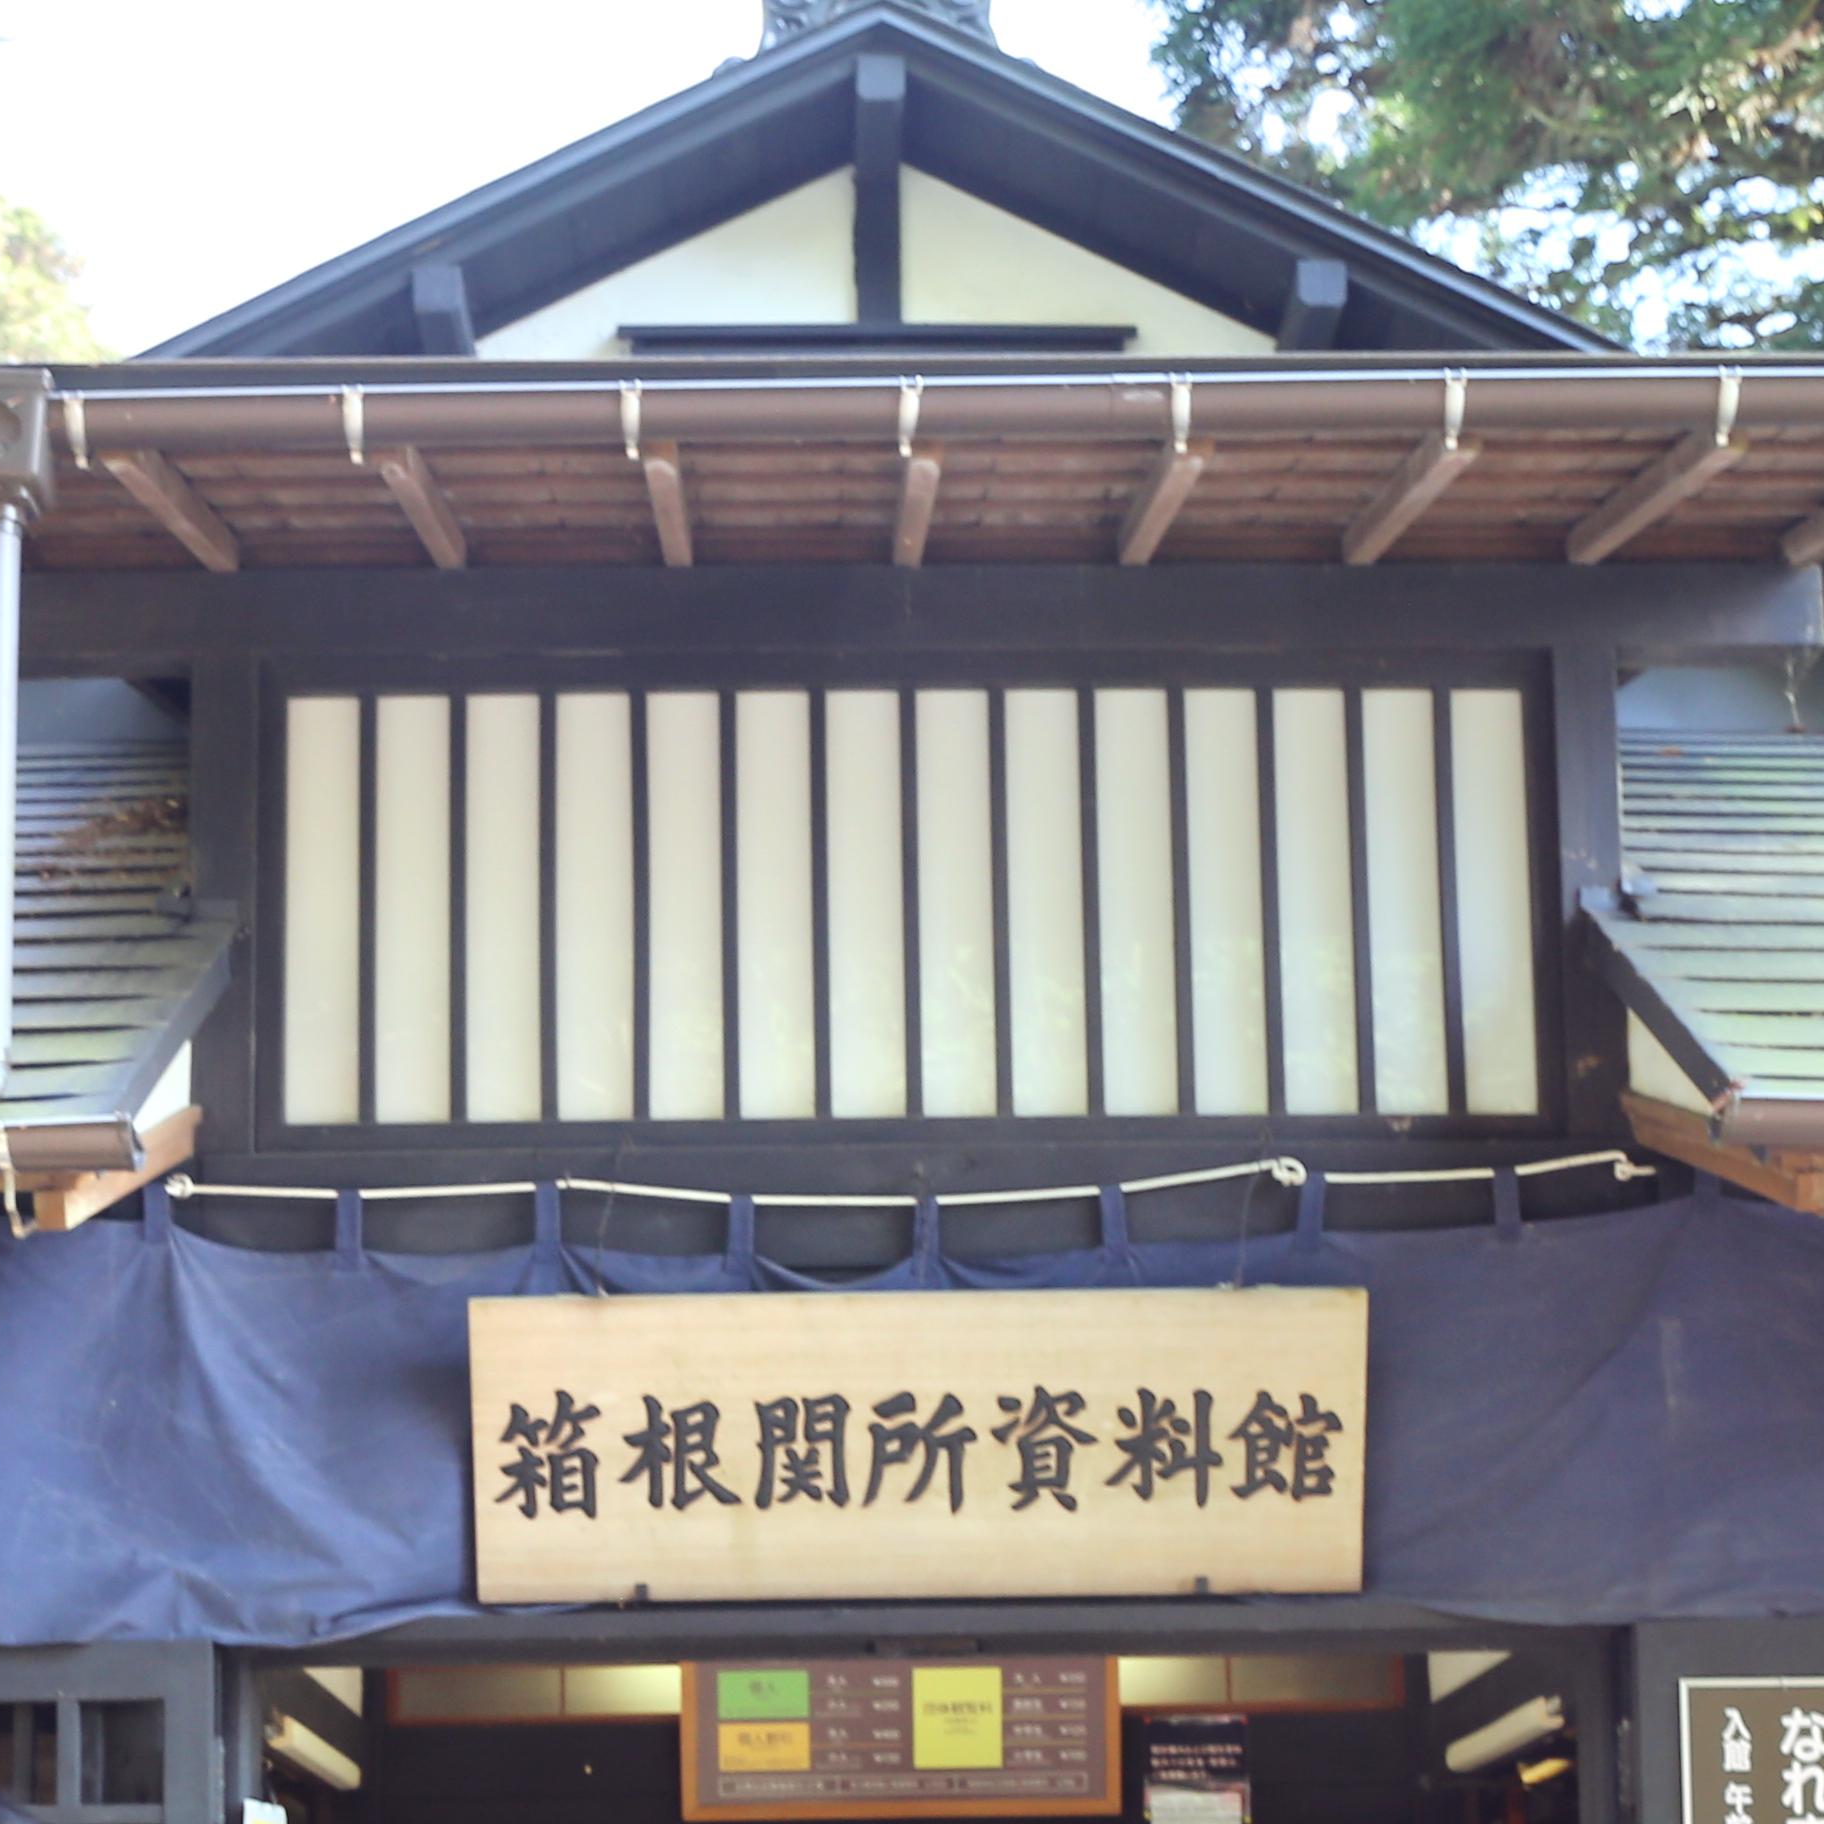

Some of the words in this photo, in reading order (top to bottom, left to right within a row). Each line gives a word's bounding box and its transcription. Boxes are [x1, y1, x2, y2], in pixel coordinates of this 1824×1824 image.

[494, 1387, 1344, 1520] 箱根関所資料館
